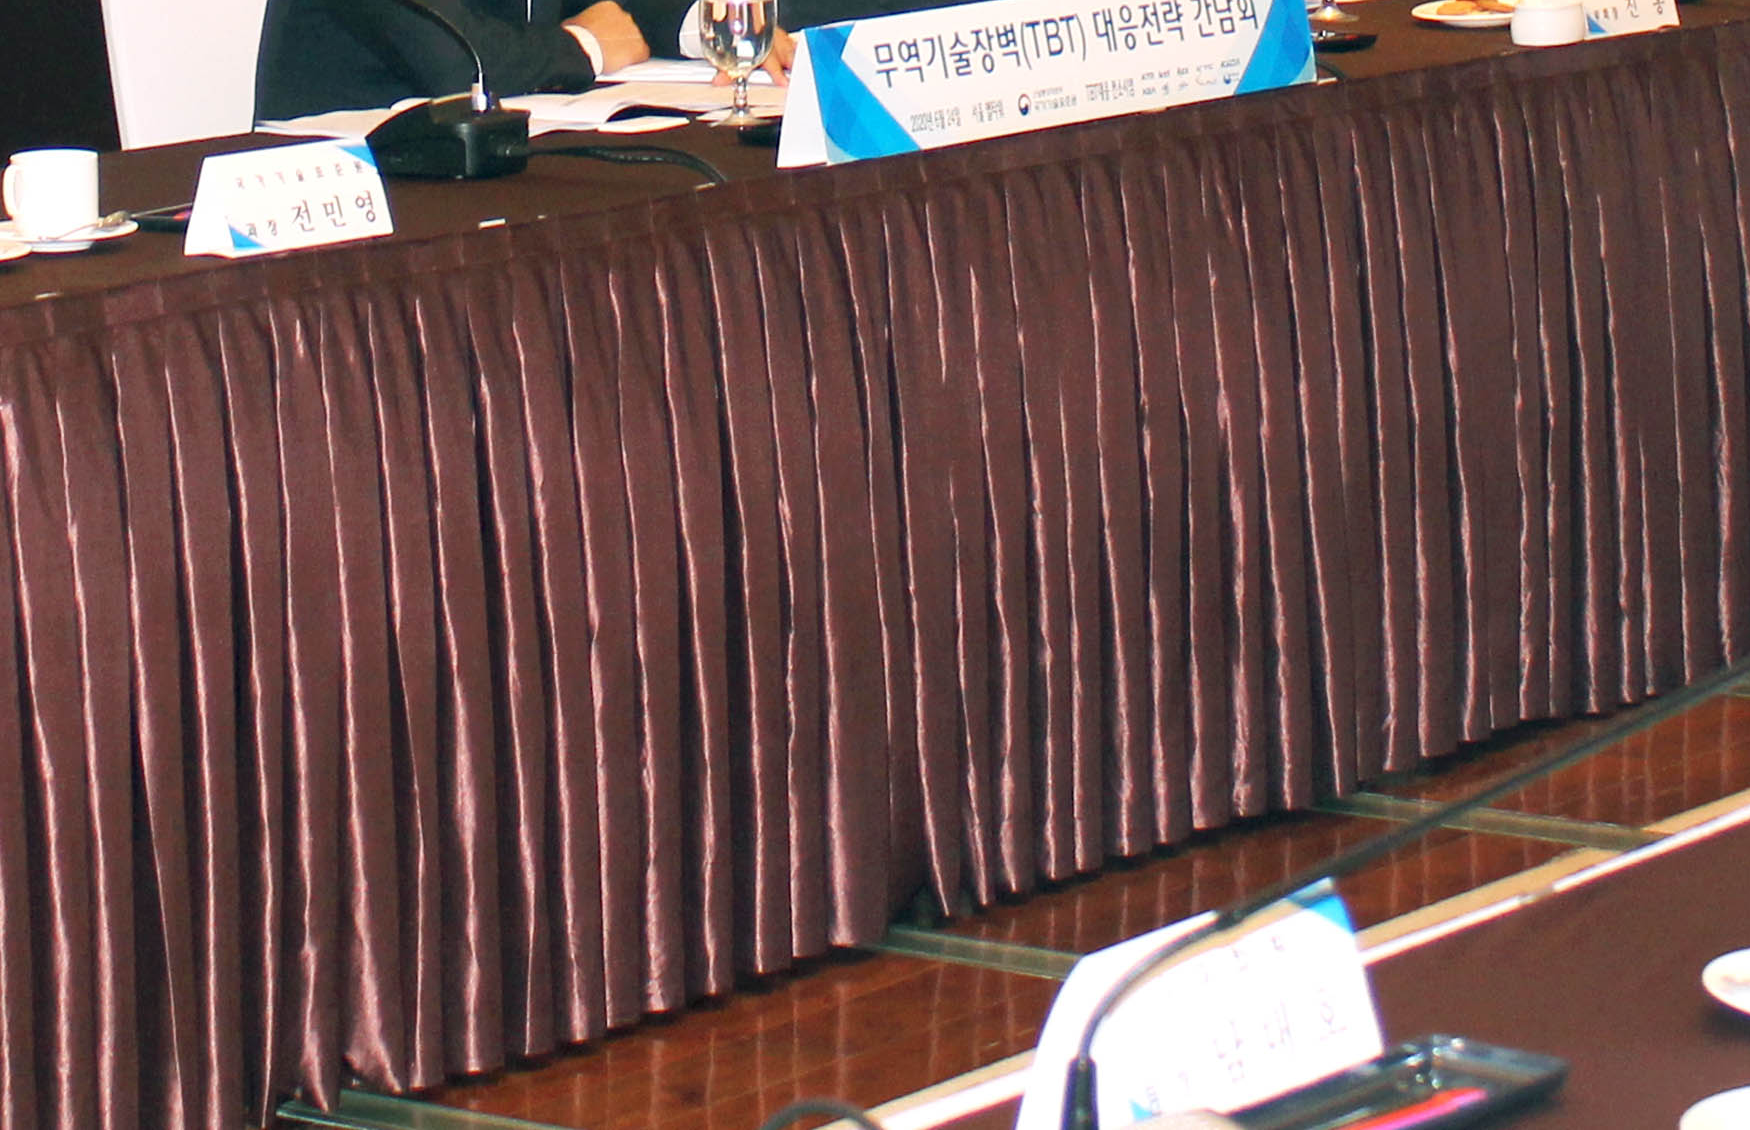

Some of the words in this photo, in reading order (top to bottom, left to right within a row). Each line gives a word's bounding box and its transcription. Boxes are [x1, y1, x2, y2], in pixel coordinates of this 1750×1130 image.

[873, 14, 1087, 89] 무역기술장벽(TBT)
[1093, 2, 1185, 54] 대응전략
[292, 190, 376, 232] 전민영
